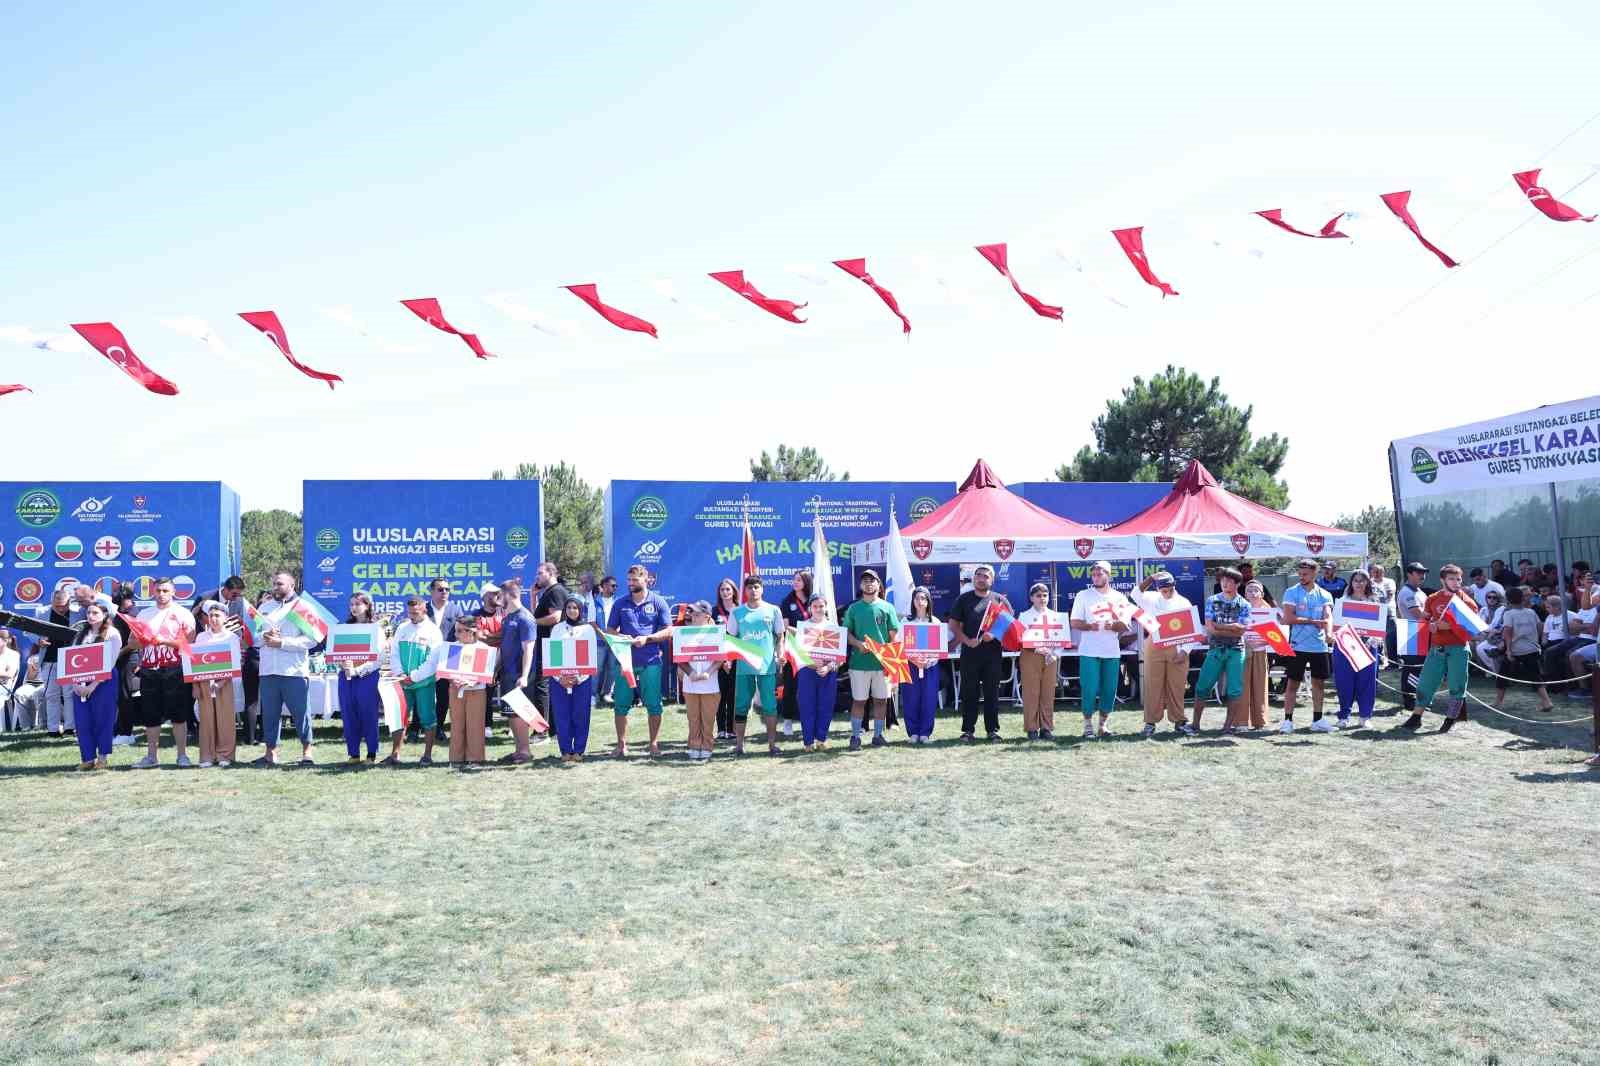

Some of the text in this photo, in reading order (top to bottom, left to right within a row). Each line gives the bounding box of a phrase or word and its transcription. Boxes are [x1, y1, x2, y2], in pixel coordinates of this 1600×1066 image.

[1437, 423, 1600, 466] GELENEKSEL KARA
[1488, 458, 1521, 474] GÜREŞ
[352, 527, 495, 542] ULUSLARARASI
[353, 543, 495, 554] SULTANGAZİ BELEDİYESİ
[715, 538, 793, 566] HAIRA
[352, 562, 494, 579] GELENEKSEL
